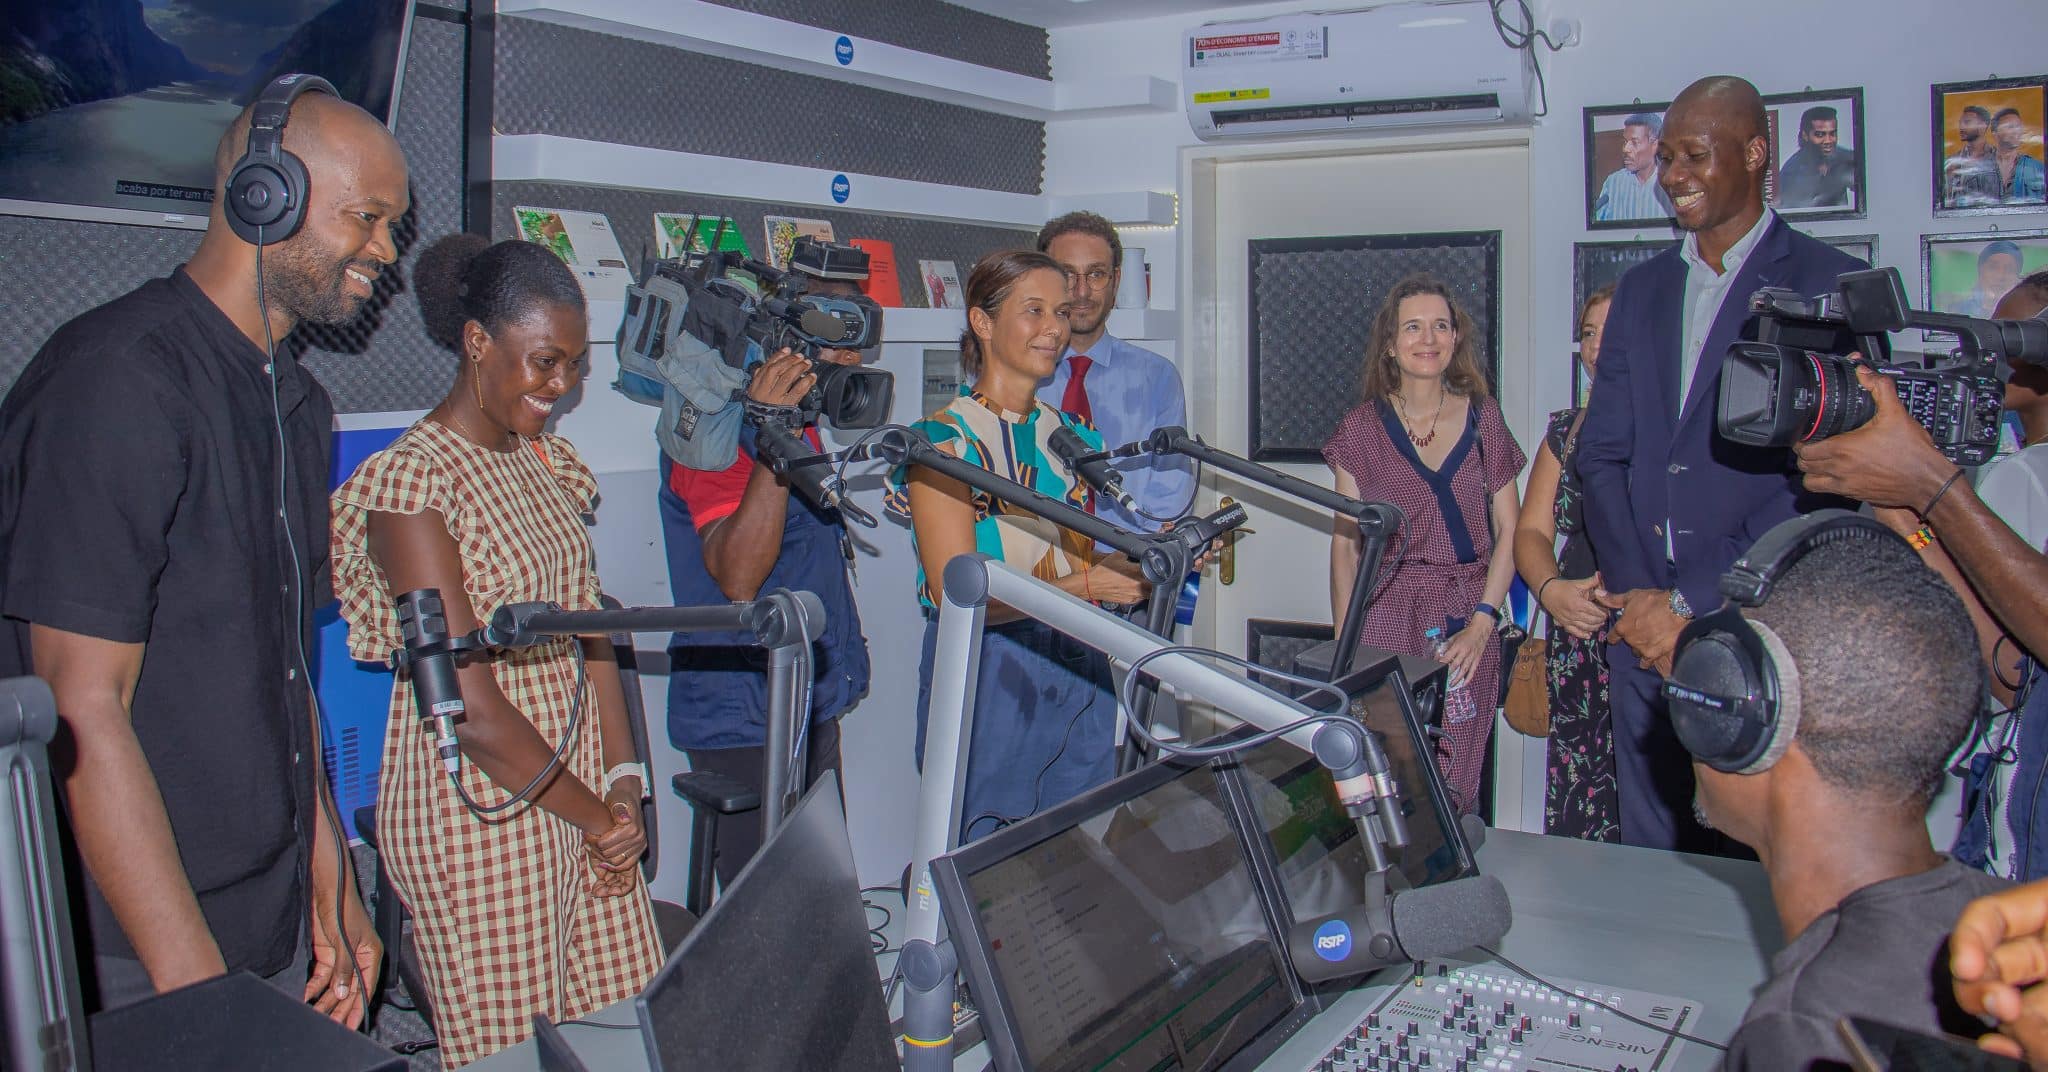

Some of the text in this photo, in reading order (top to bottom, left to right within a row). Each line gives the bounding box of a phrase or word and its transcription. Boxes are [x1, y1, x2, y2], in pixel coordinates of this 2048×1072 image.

[117, 184, 148, 195] acaba
[150, 187, 167, 197] por
[169, 188, 184, 198] ter
[185, 192, 201, 200] um
[1318, 934, 1345, 949] RSTP
[1556, 1031, 1656, 1055] AIRENCE
